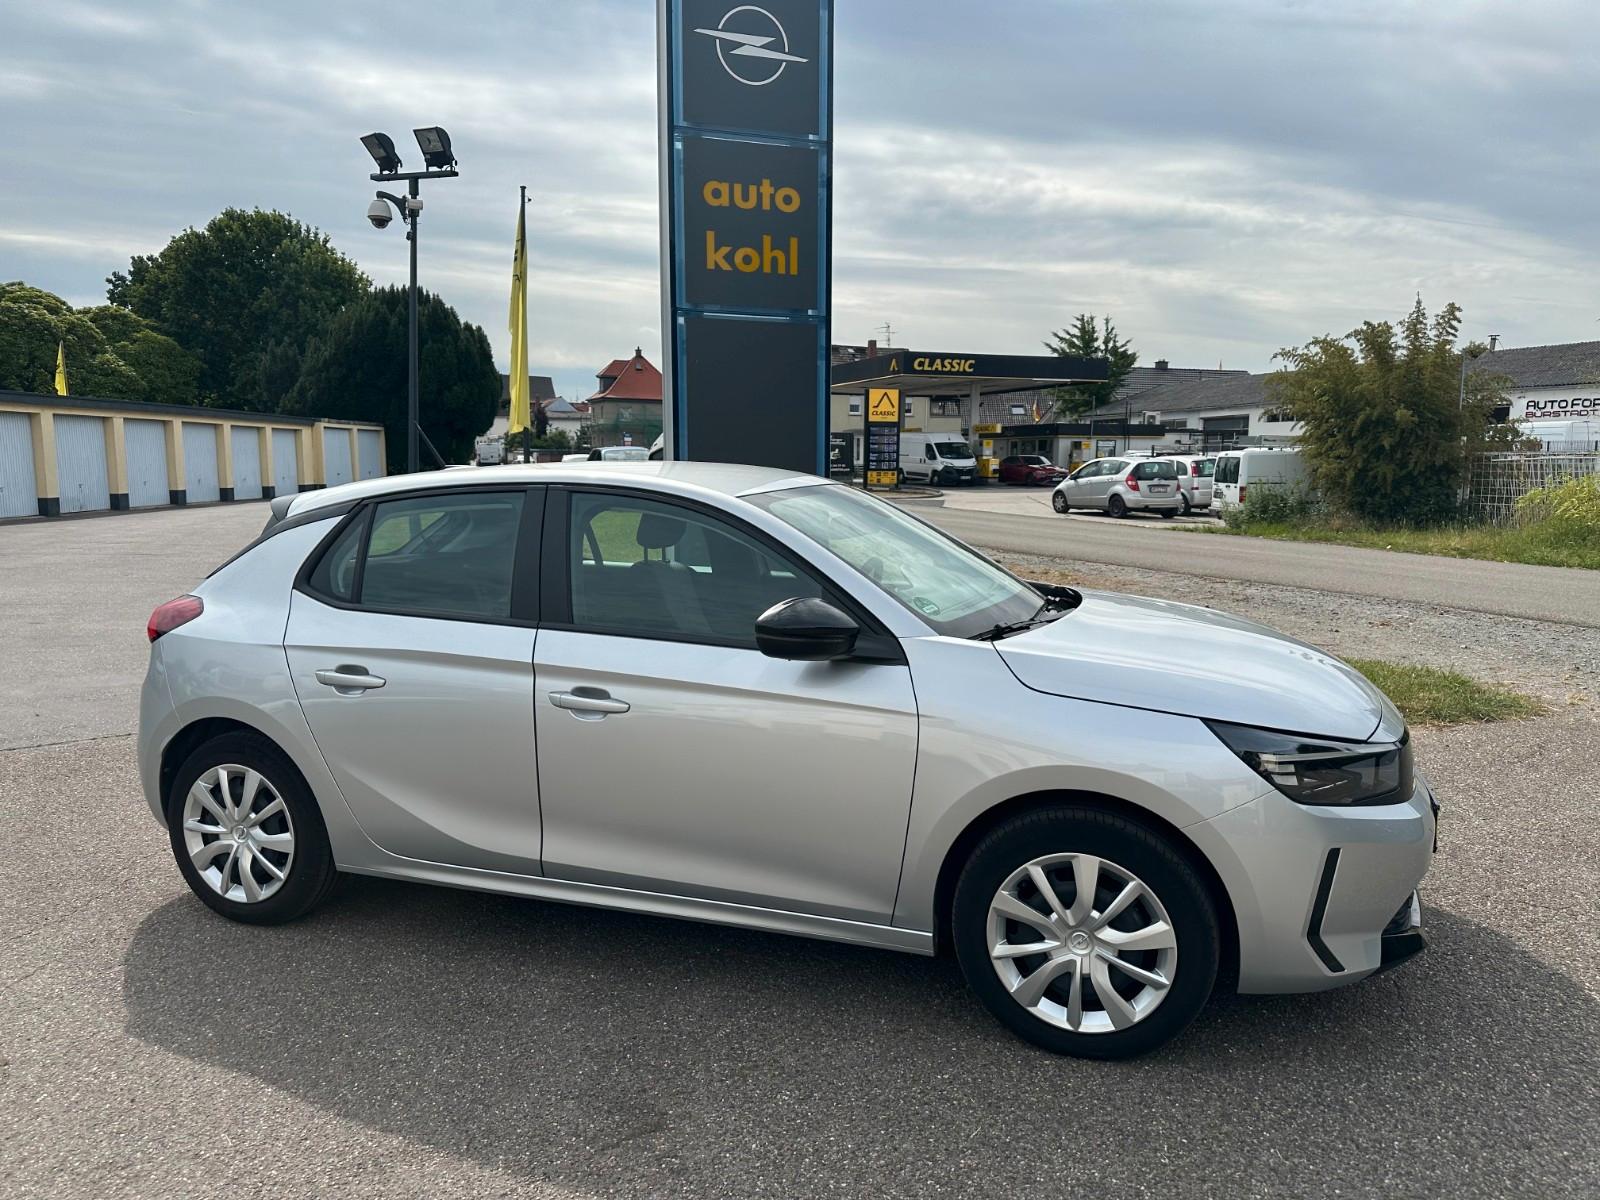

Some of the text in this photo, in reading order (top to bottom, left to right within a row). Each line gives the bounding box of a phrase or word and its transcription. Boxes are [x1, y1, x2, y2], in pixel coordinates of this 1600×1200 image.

[703, 178, 801, 213] auto
[706, 230, 798, 276] kohl
[913, 357, 976, 373] CLASSIC
[1526, 399, 1568, 410] AUTO
